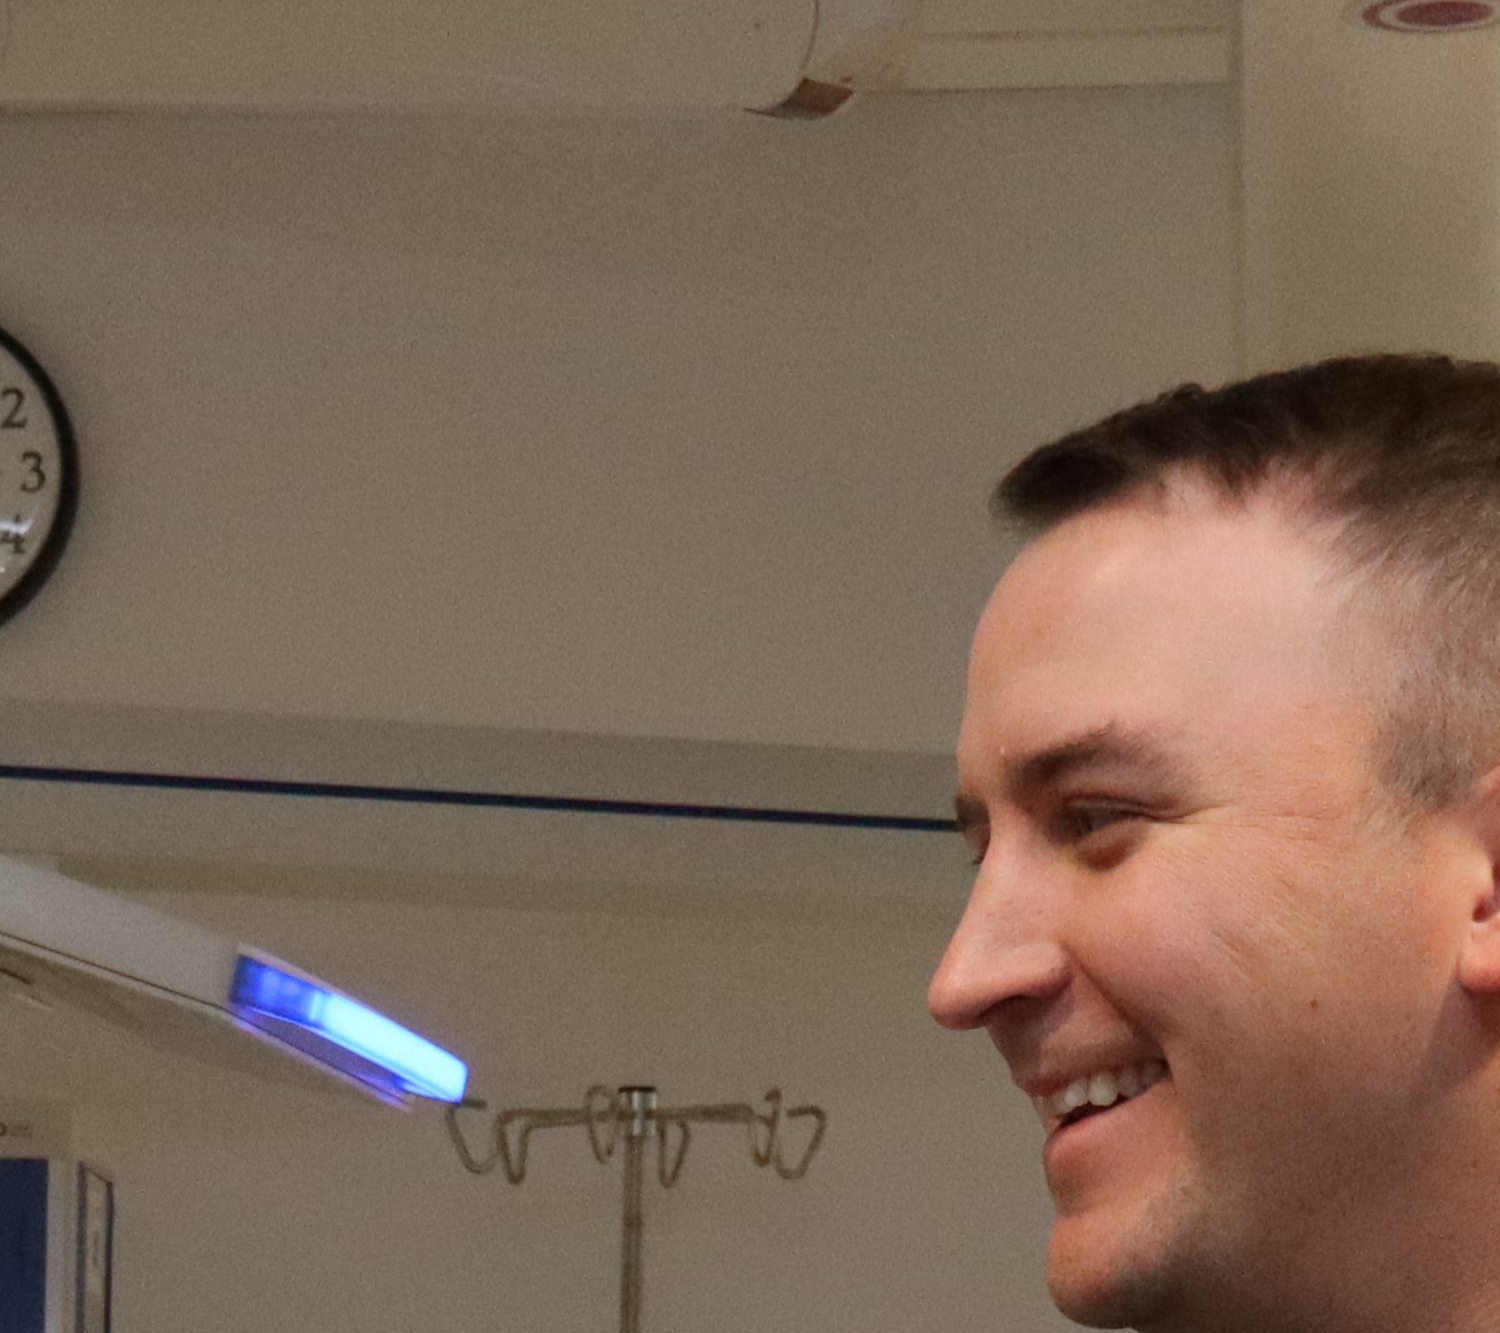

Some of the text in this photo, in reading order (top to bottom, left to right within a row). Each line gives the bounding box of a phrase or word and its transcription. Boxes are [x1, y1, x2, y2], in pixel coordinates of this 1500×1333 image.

[0, 387, 27, 430] 2
[20, 451, 46, 494] 3
[0, 515, 26, 554] 4
